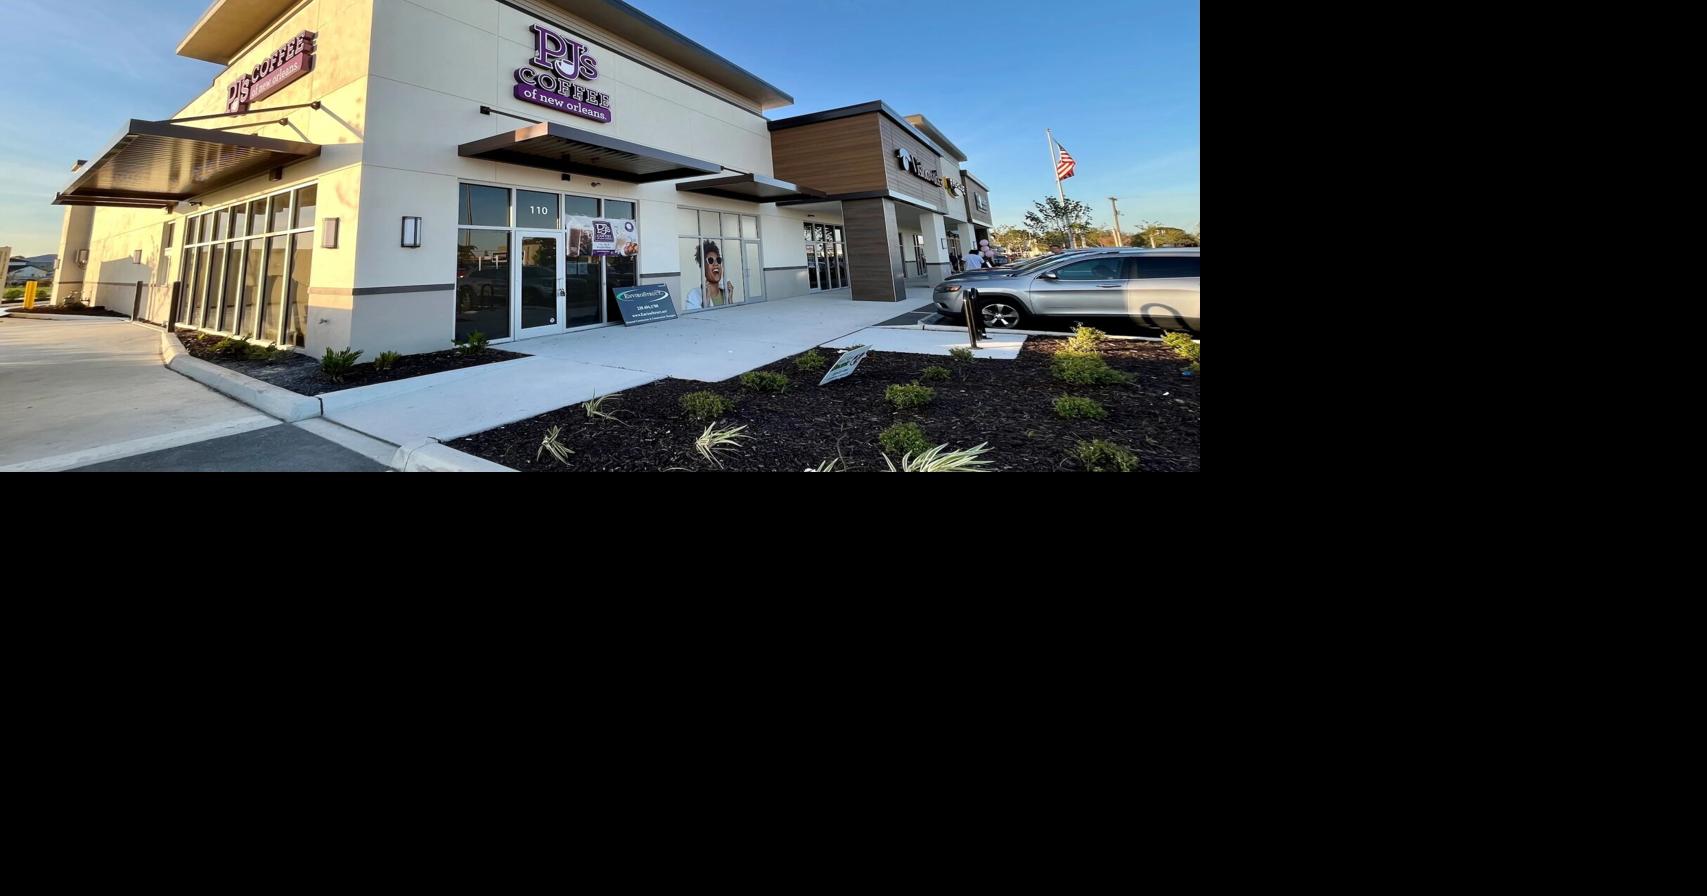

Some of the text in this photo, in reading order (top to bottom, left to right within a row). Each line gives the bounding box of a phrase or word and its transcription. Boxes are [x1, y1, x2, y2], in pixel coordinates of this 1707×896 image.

[251, 31, 306, 84] COFFEE
[530, 24, 598, 81] PJ's
[225, 74, 250, 113] PJ's
[516, 67, 610, 109] COFFEE
[523, 89, 538, 100] of
[540, 95, 564, 107] new
[530, 205, 548, 215] 110
